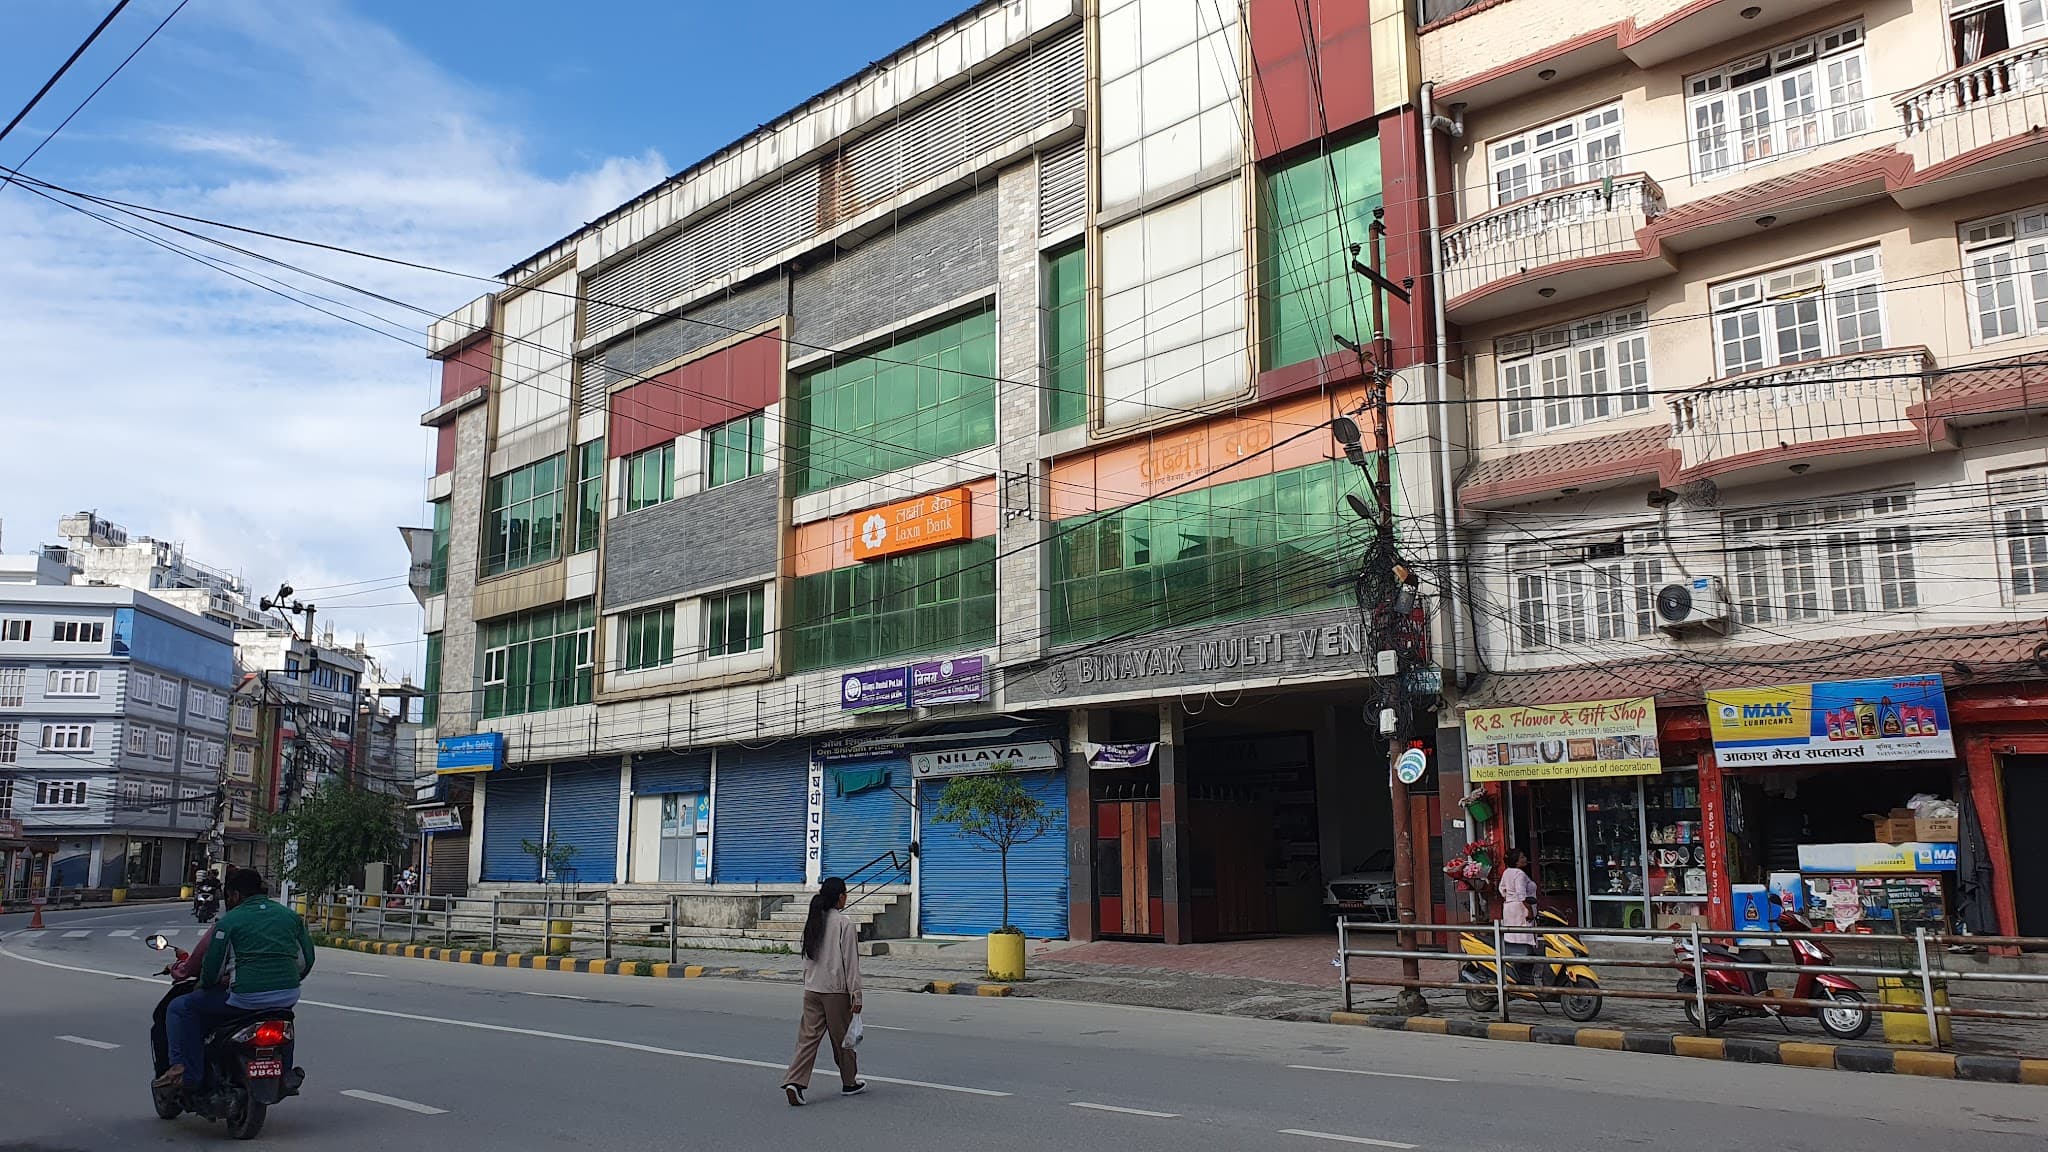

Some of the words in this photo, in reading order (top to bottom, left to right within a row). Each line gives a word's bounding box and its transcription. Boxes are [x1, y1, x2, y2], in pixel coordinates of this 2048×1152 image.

[926, 512, 953, 535] Bank
[1076, 644, 1185, 683] BINAYAK
[1198, 633, 1283, 674] MULTI
[1510, 709, 1556, 729] Flower
[1559, 710, 1575, 729] &
[1578, 704, 1607, 728] Gift
[1609, 703, 1647, 728] Shop
[1743, 701, 1793, 719] MAK
[1744, 717, 1794, 727] LUBRICANTS
[937, 748, 1023, 765] NILAYA
[1724, 752, 1768, 762] आकाश
[1772, 748, 1801, 760] भैरव
[1805, 745, 1865, 759] सप्लायर्स
[1498, 766, 1539, 777] Remember
[1541, 767, 1550, 775] us
[1552, 764, 1563, 775] for
[1564, 765, 1579, 777] any
[1580, 761, 1598, 773] kind
[1599, 761, 1608, 772] of
